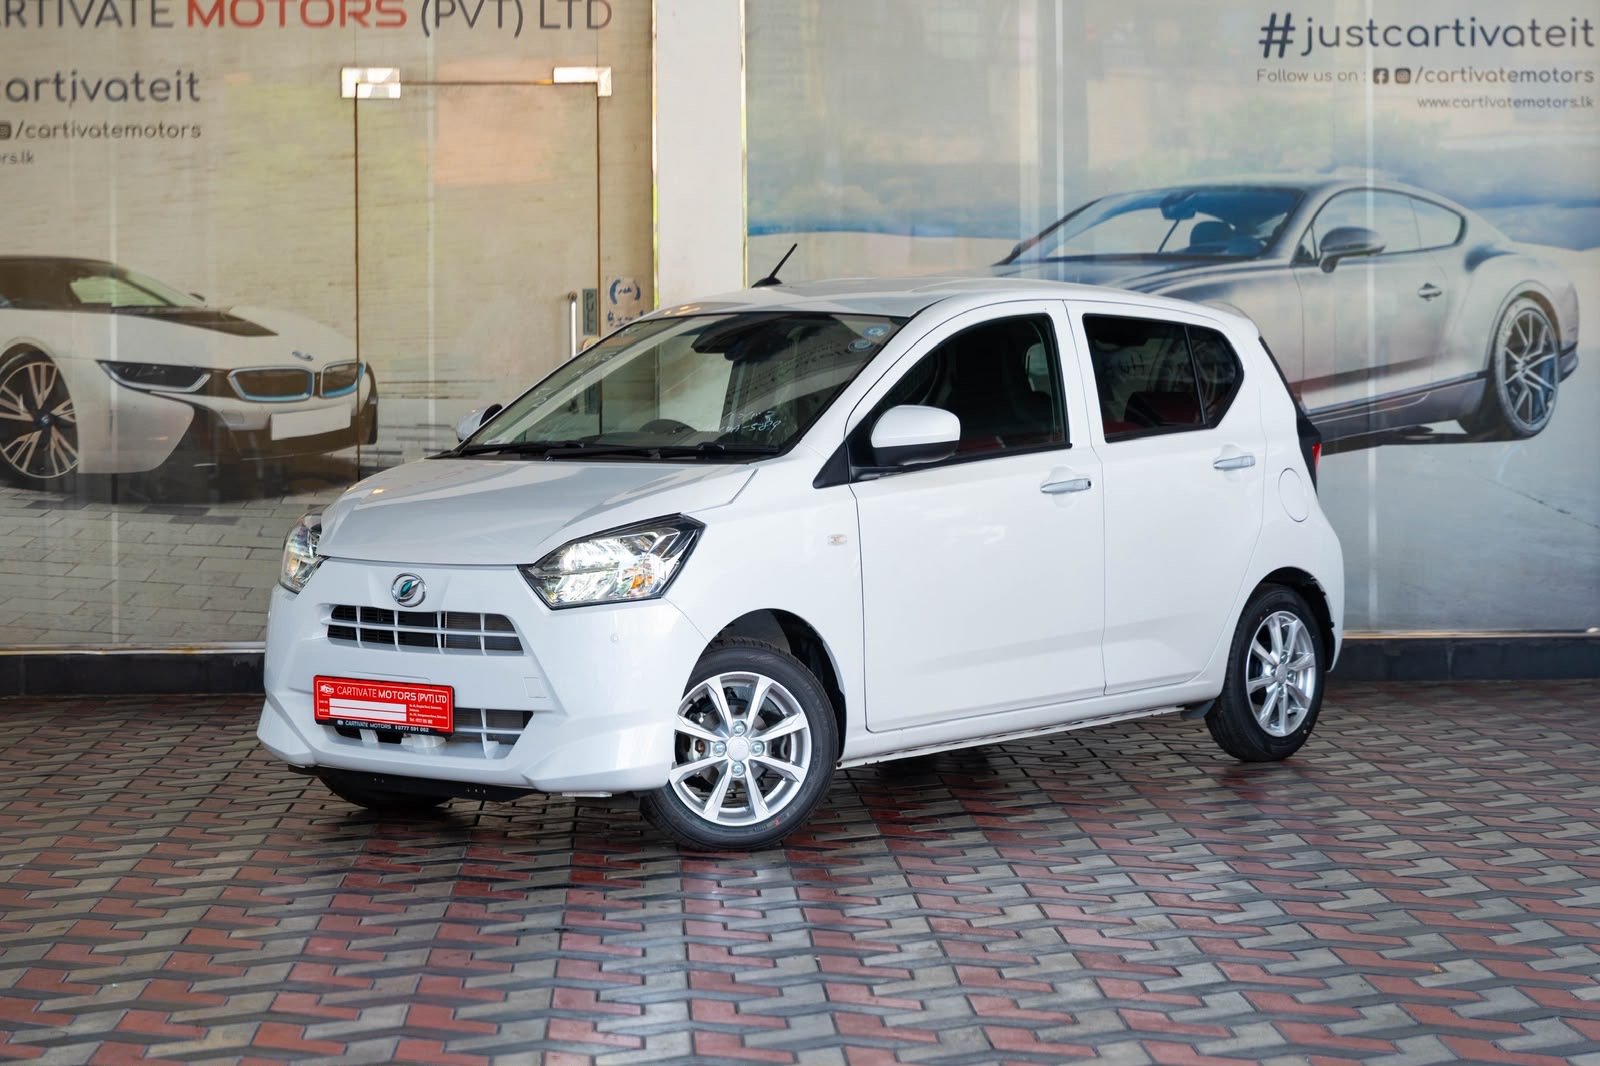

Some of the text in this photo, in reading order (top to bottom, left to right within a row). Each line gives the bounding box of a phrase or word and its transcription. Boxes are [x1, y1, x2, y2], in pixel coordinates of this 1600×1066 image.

[0, 0, 613, 37] RTIVATE MOTORS (PVT) LTD
[1258, 12, 1596, 58] #justcartivateit
[1256, 69, 1309, 83] Follow
[1313, 73, 1332, 83] us
[1337, 73, 1358, 83] on
[1415, 66, 1595, 85] /cartivatemotors
[0, 69, 201, 102] artivateit
[1417, 95, 1594, 109] www.cartivatemotors.lk
[15, 120, 202, 140] /cartivatemotors
[0, 150, 34, 165] rs.lk
[337, 686, 447, 704] CARTIVATE MOTORS (PVT) LTD
